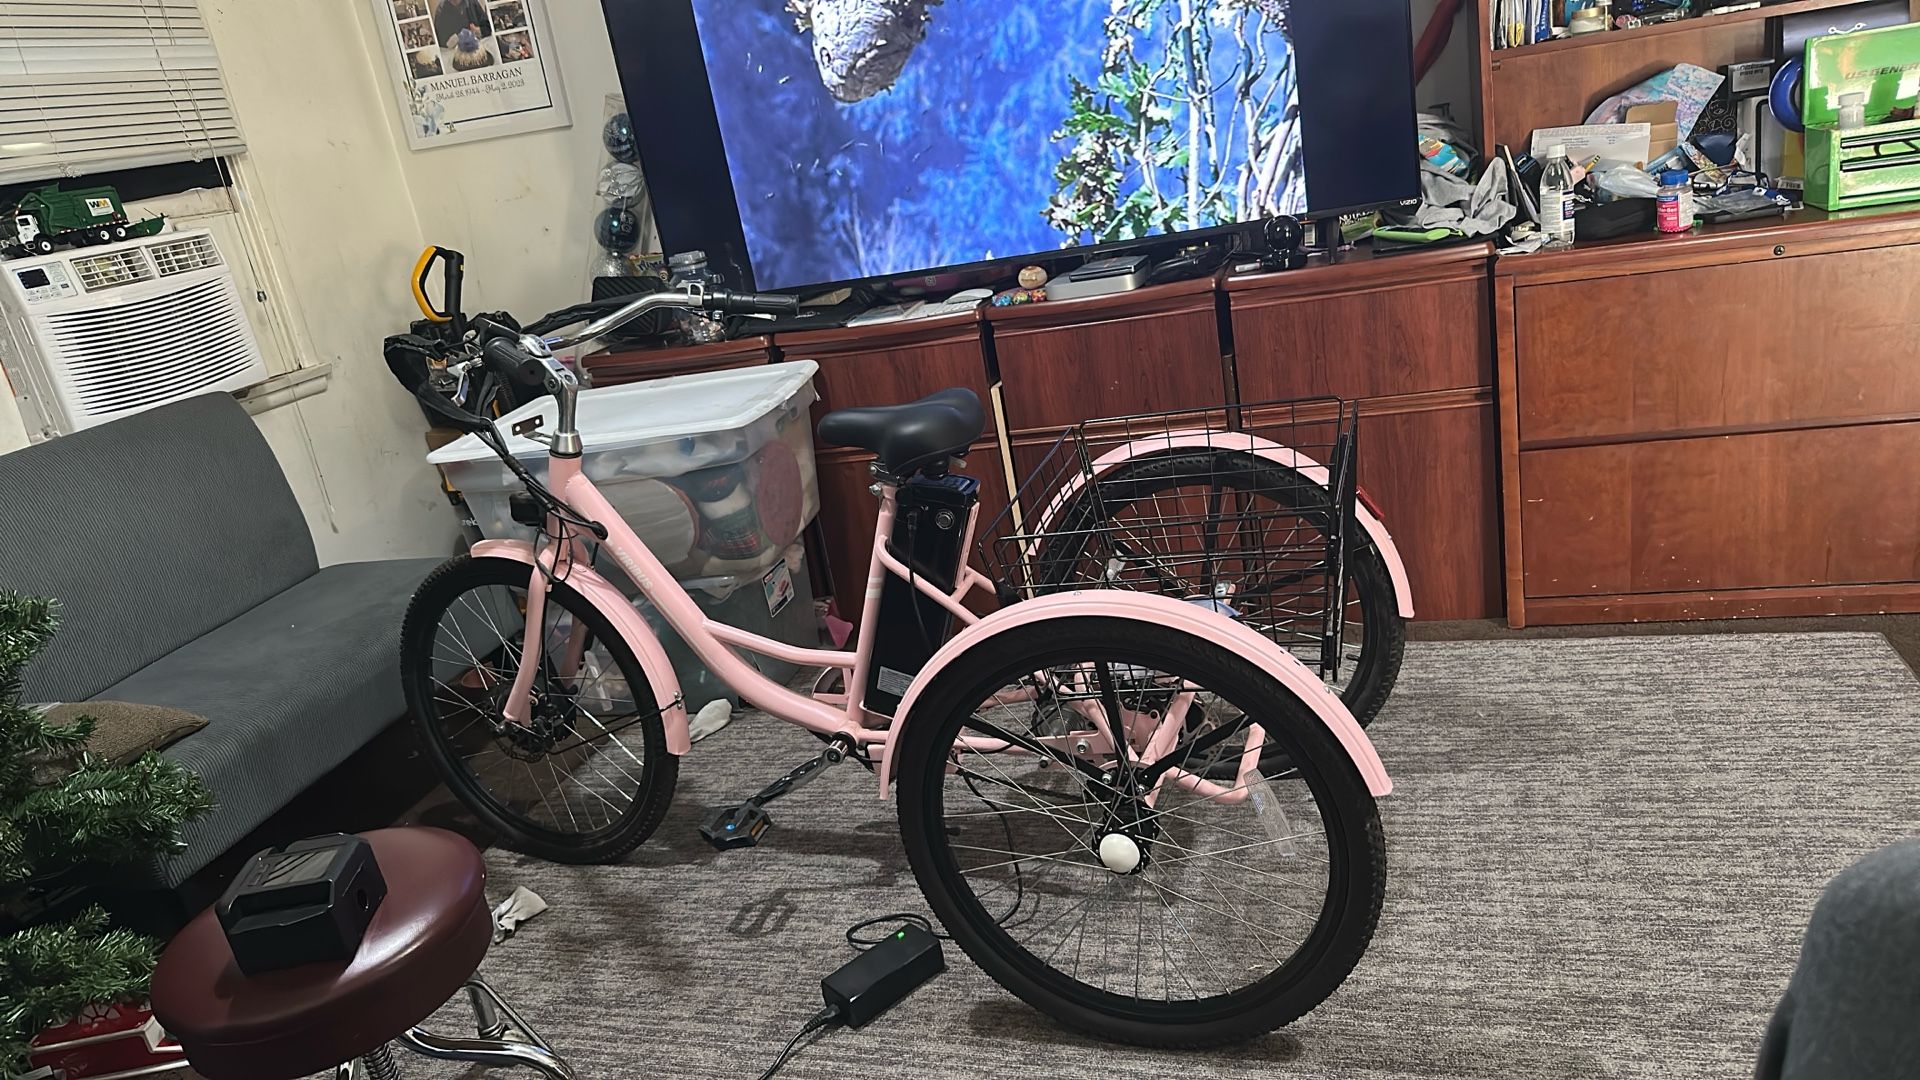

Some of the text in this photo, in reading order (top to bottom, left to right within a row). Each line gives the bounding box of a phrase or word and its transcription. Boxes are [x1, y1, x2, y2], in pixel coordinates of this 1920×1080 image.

[430, 67, 522, 91] MANUEL BARRAGAN
[88, 199, 109, 208] WM
[1399, 198, 1418, 206] VIZIO
[616, 546, 653, 589] VIRIBUS
